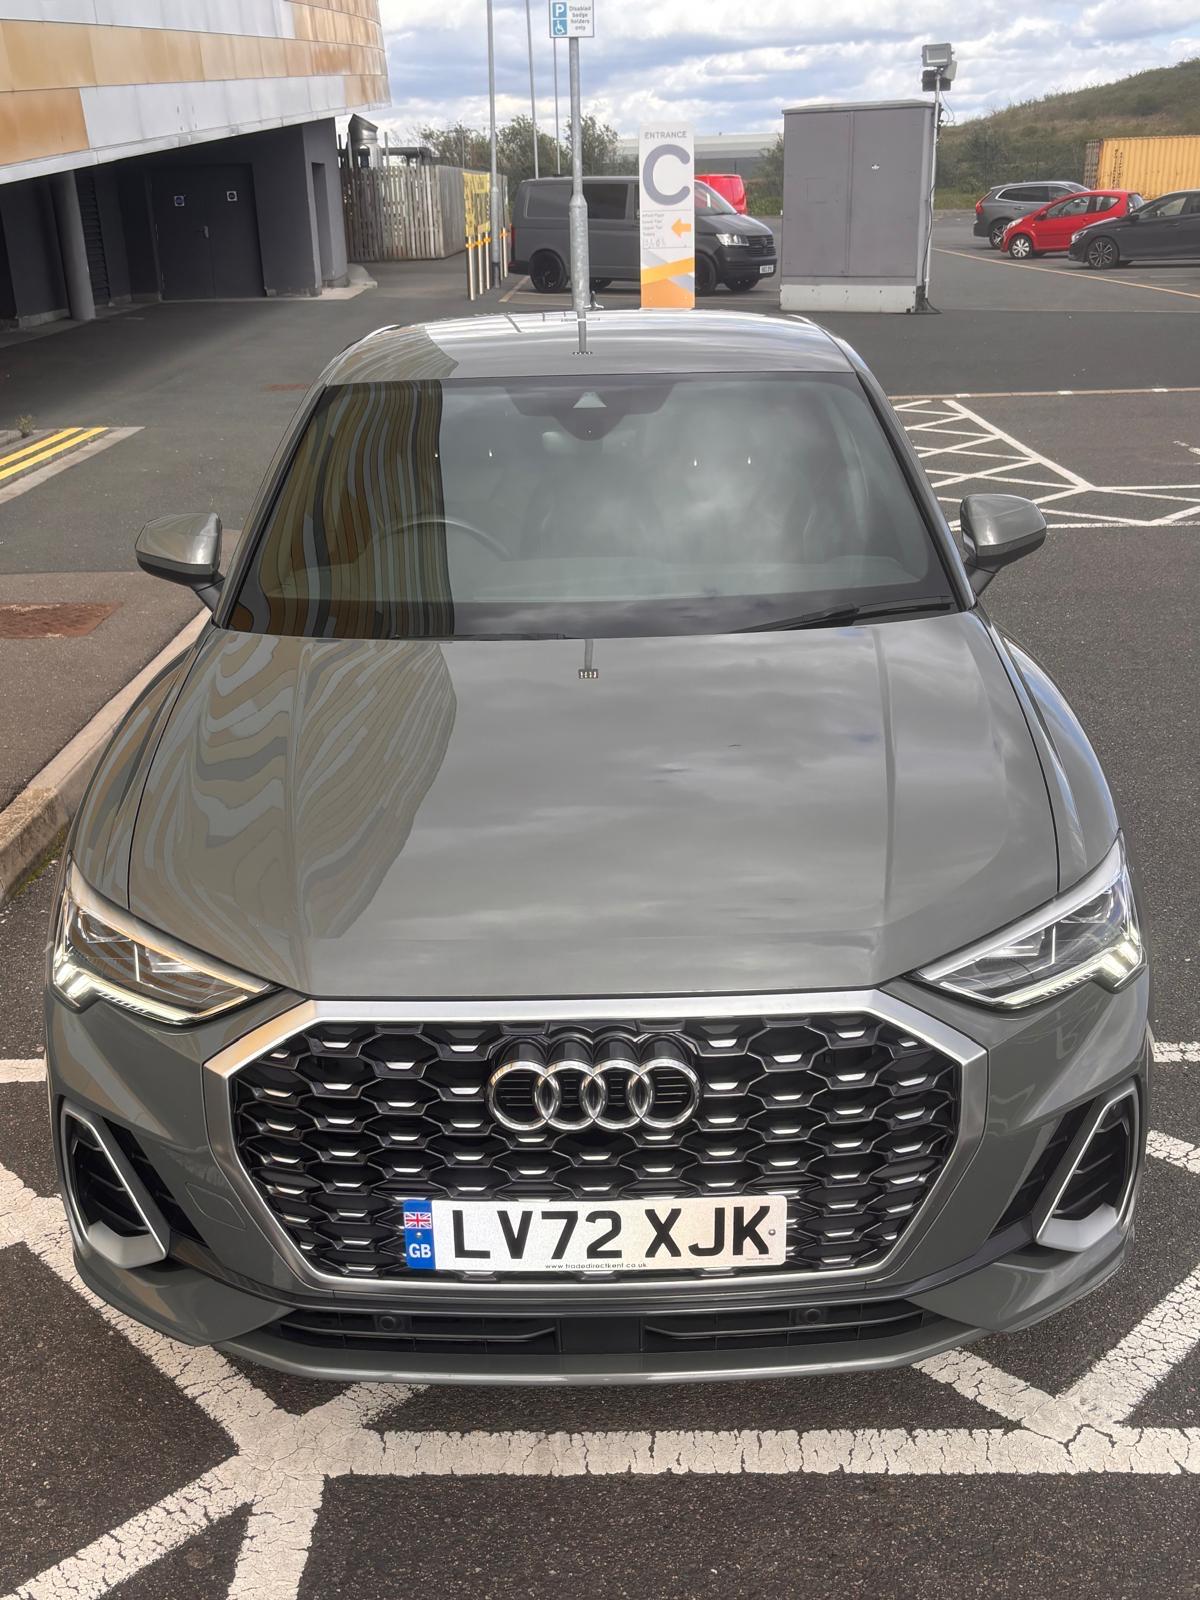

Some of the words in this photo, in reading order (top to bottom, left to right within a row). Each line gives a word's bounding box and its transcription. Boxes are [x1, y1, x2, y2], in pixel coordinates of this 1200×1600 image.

[556, 4, 565, 17] P
[644, 131, 688, 139] ENTRANCE
[642, 144, 690, 206] C
[452, 1209, 623, 1259] LV72
[644, 1205, 770, 1258] XJK
[409, 1243, 431, 1258] GB
